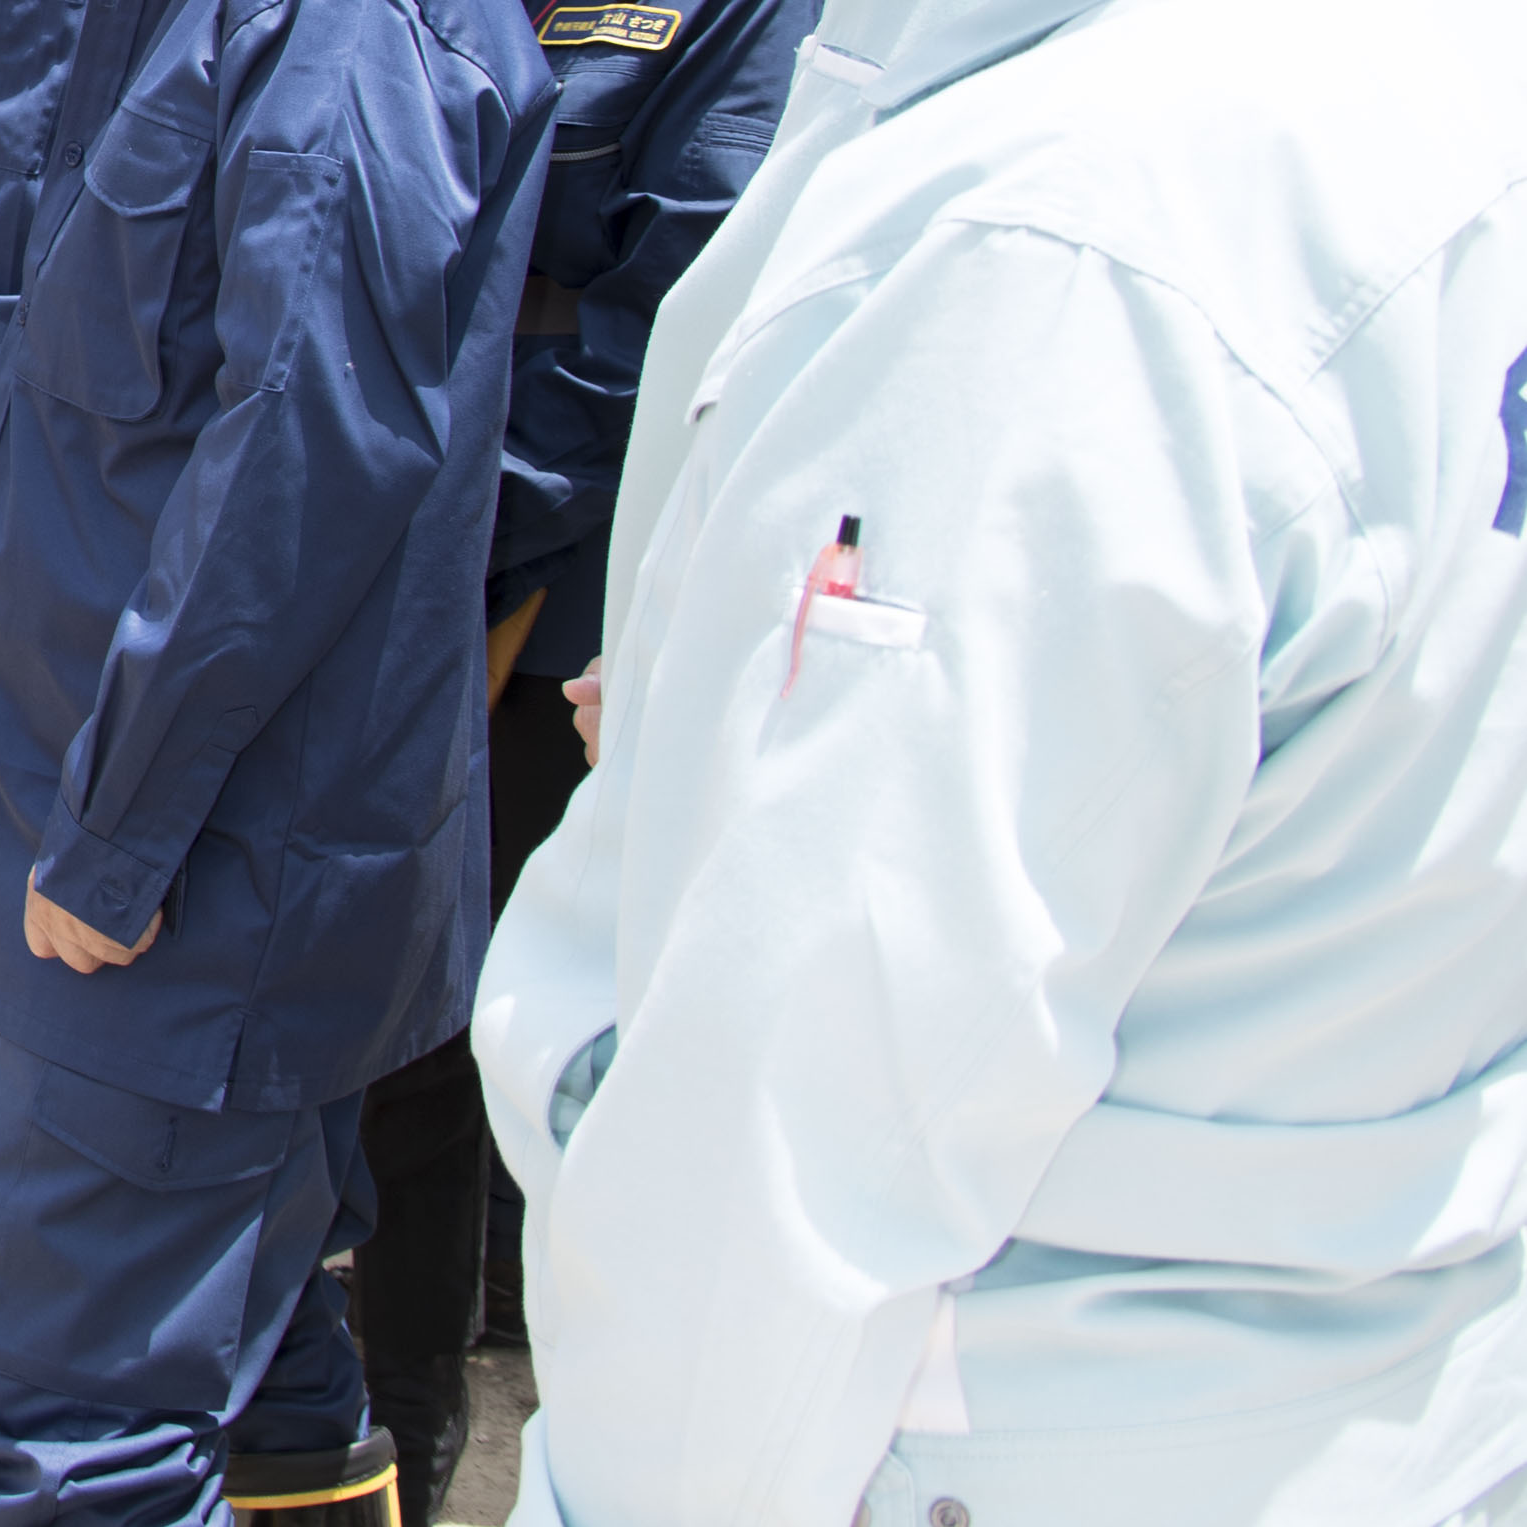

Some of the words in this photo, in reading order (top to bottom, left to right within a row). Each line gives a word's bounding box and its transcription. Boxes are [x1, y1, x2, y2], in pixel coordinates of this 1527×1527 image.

[599, 12, 627, 25] 片山
[628, 16, 667, 31] さつき
